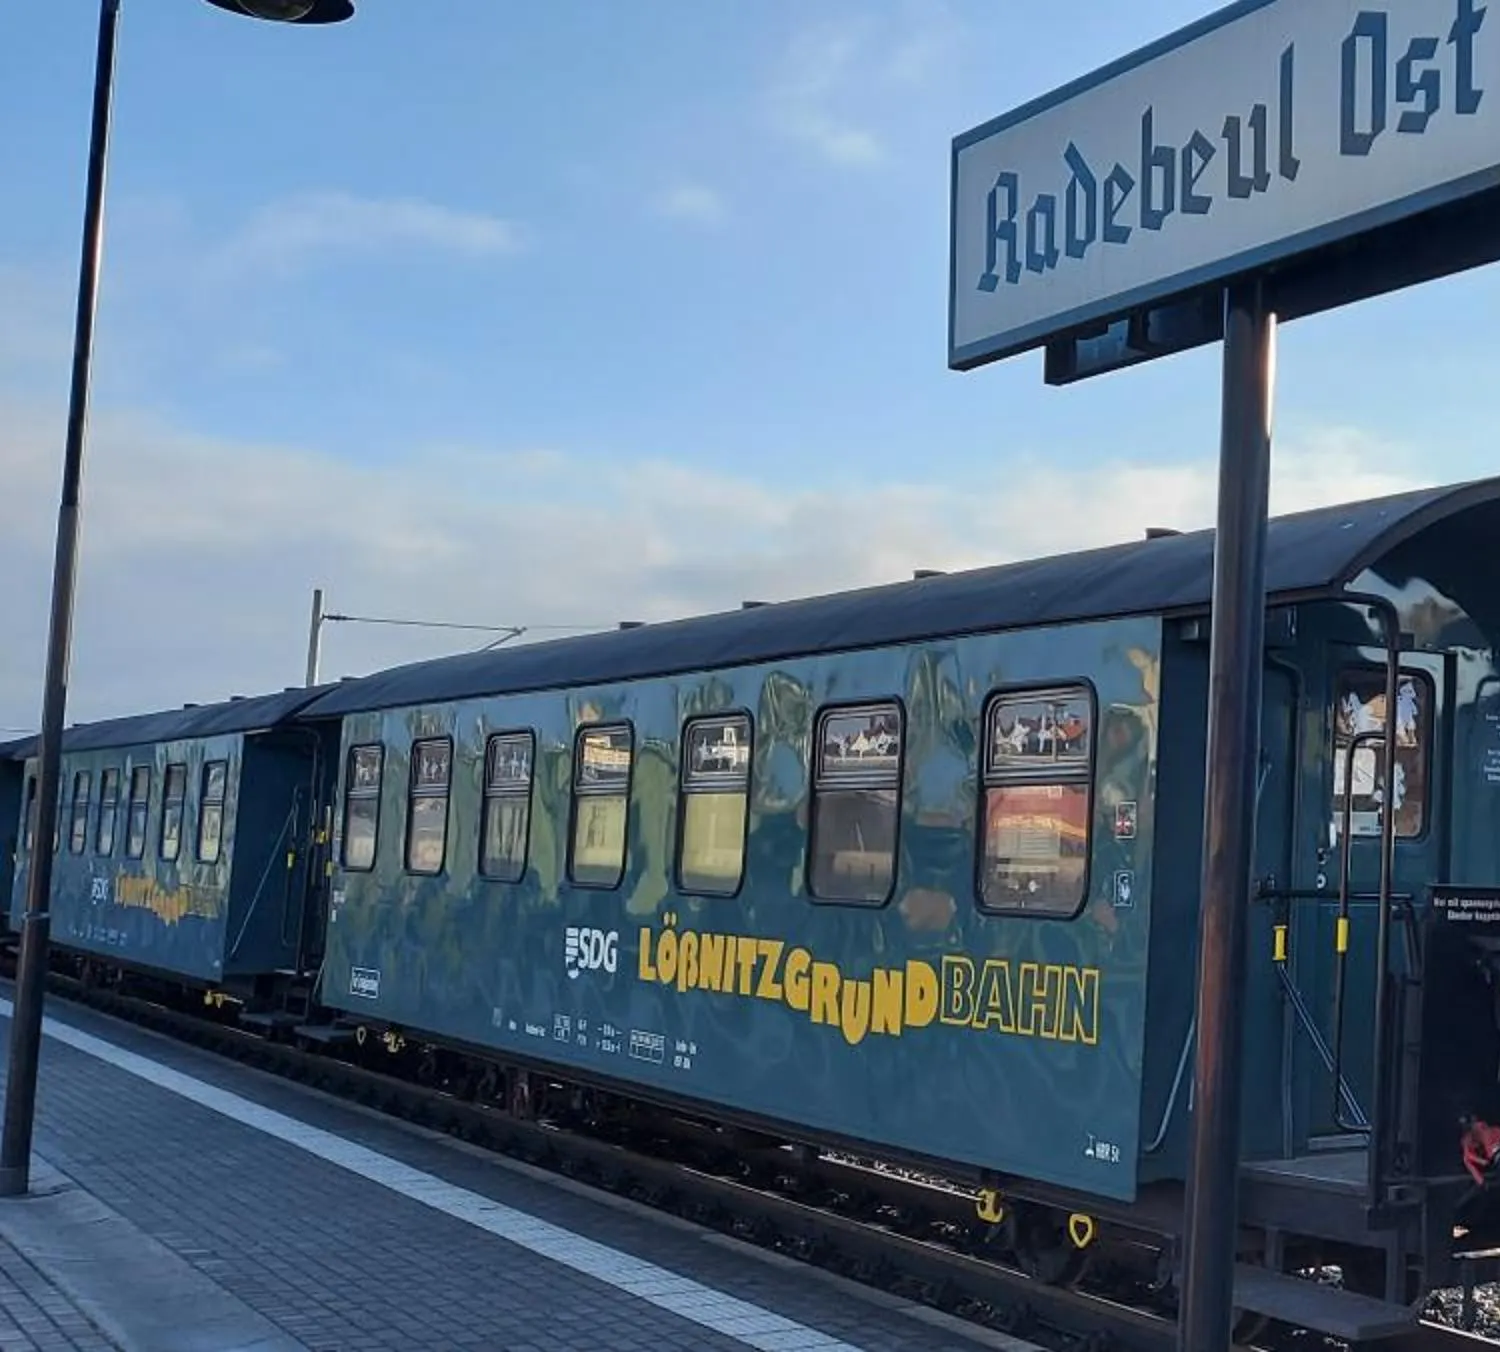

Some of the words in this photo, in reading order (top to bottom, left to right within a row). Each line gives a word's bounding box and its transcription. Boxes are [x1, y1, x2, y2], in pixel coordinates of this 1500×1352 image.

[977, 42, 1300, 293] Radebeul
[1339, 0, 1487, 156] Ost
[577, 928, 619, 973] SDG
